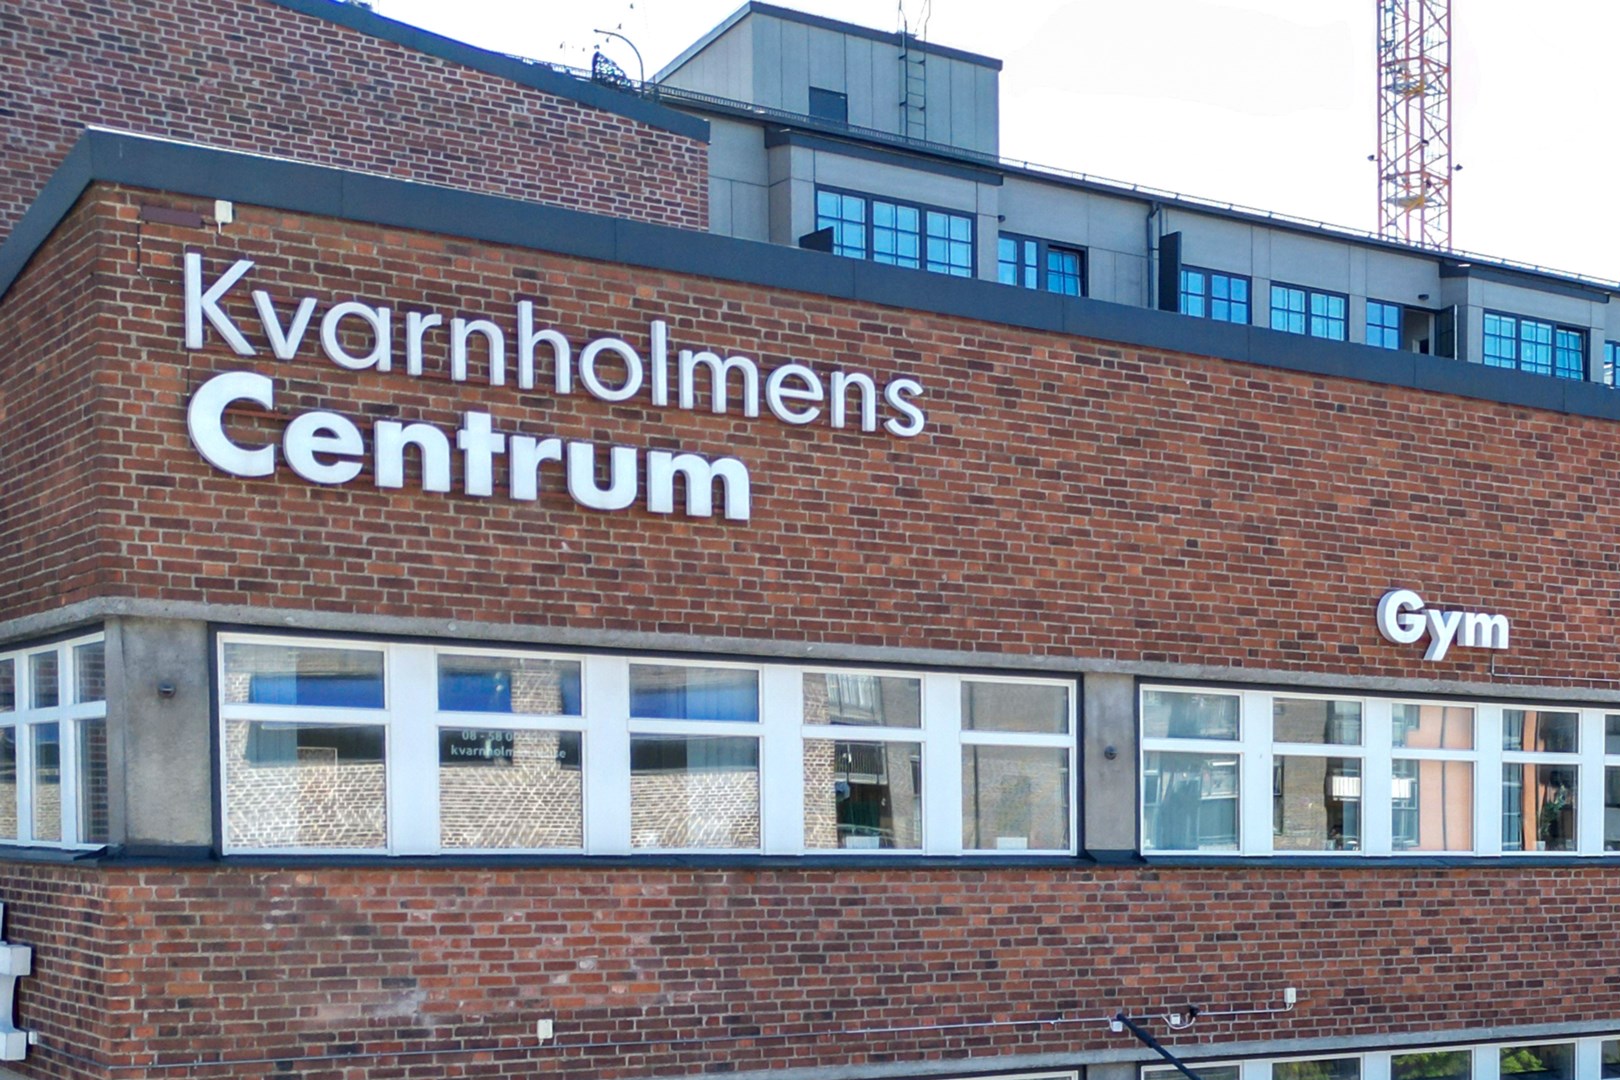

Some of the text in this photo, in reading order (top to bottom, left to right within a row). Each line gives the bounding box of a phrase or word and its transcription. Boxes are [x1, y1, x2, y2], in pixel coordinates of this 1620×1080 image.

[184, 252, 925, 438] Kvarnholmens
[186, 371, 751, 520] Centrum
[1376, 589, 1510, 662] Gym
